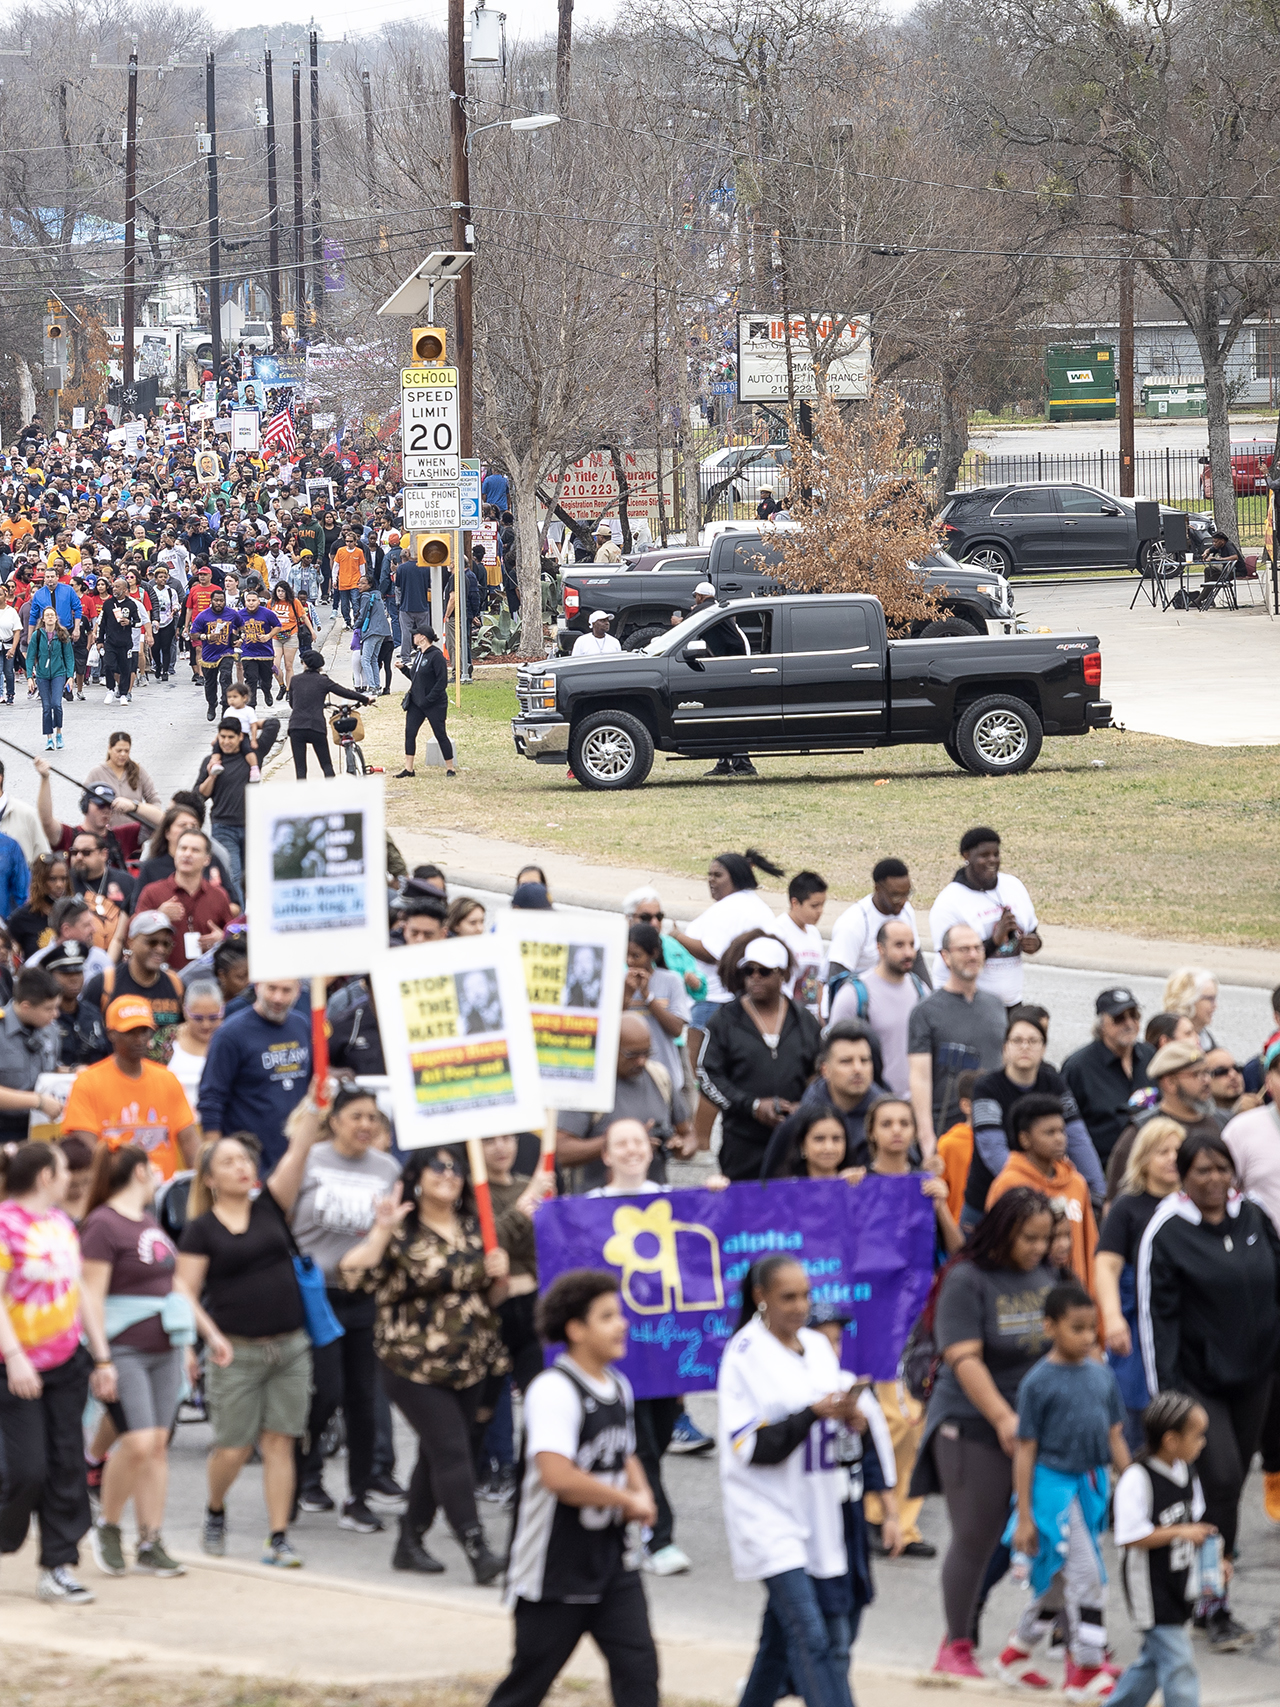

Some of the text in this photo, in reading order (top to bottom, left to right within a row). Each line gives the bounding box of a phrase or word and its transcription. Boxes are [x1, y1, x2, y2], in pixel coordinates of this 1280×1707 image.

[771, 321, 860, 338] INFNIY
[405, 373, 454, 383] SCHOOL
[748, 374, 773, 383] AUTO
[775, 373, 800, 383] TITE
[808, 373, 863, 382] INURANCE
[407, 391, 453, 402] SPEED
[412, 407, 448, 418] LIMIT
[410, 423, 452, 450] 20
[417, 458, 446, 467] WHEN
[407, 468, 456, 478] FLASHING
[547, 473, 571, 483] Auo
[574, 471, 598, 482] Title
[407, 490, 457, 500] CELL PHONE
[424, 500, 440, 508] USE
[409, 509, 456, 519] PROHIBITED
[521, 942, 564, 955] STOP
[532, 965, 561, 979] THE
[400, 975, 449, 995] STOP
[418, 1000, 452, 1016] THE
[409, 1020, 456, 1041] HATE
[723, 1229, 803, 1254] alpha
[725, 1257, 843, 1282] alnae
